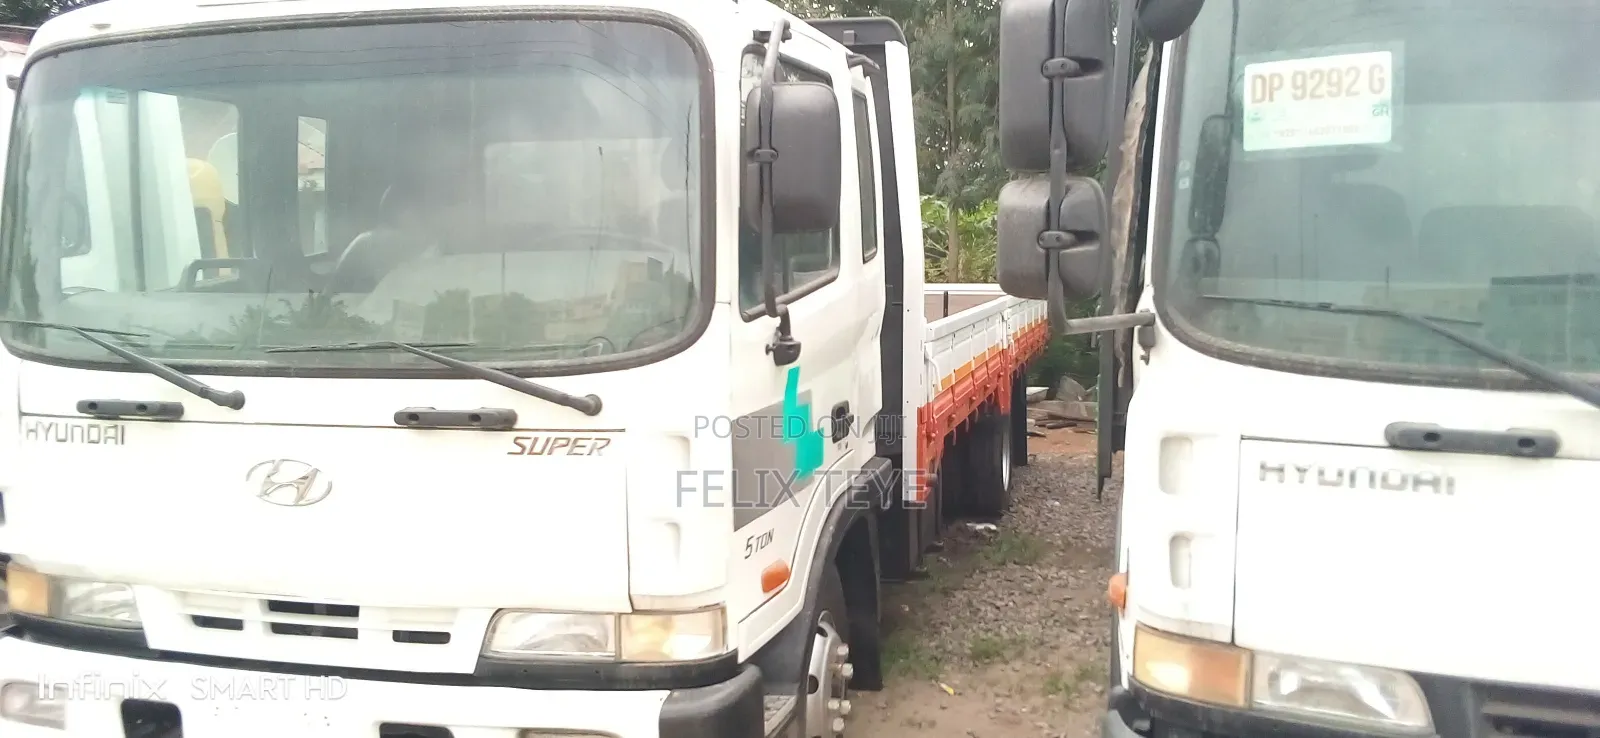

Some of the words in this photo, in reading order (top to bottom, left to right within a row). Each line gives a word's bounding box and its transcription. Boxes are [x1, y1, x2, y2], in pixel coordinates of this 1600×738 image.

[1251, 73, 1284, 104] DP
[1291, 66, 1361, 102] 9292
[1368, 64, 1385, 95] G
[26, 420, 125, 445] HYUNDAI
[507, 436, 611, 456] SUPER
[1259, 460, 1456, 496] HYUNDAI
[744, 535, 755, 560] 5
[756, 528, 775, 552] TON
